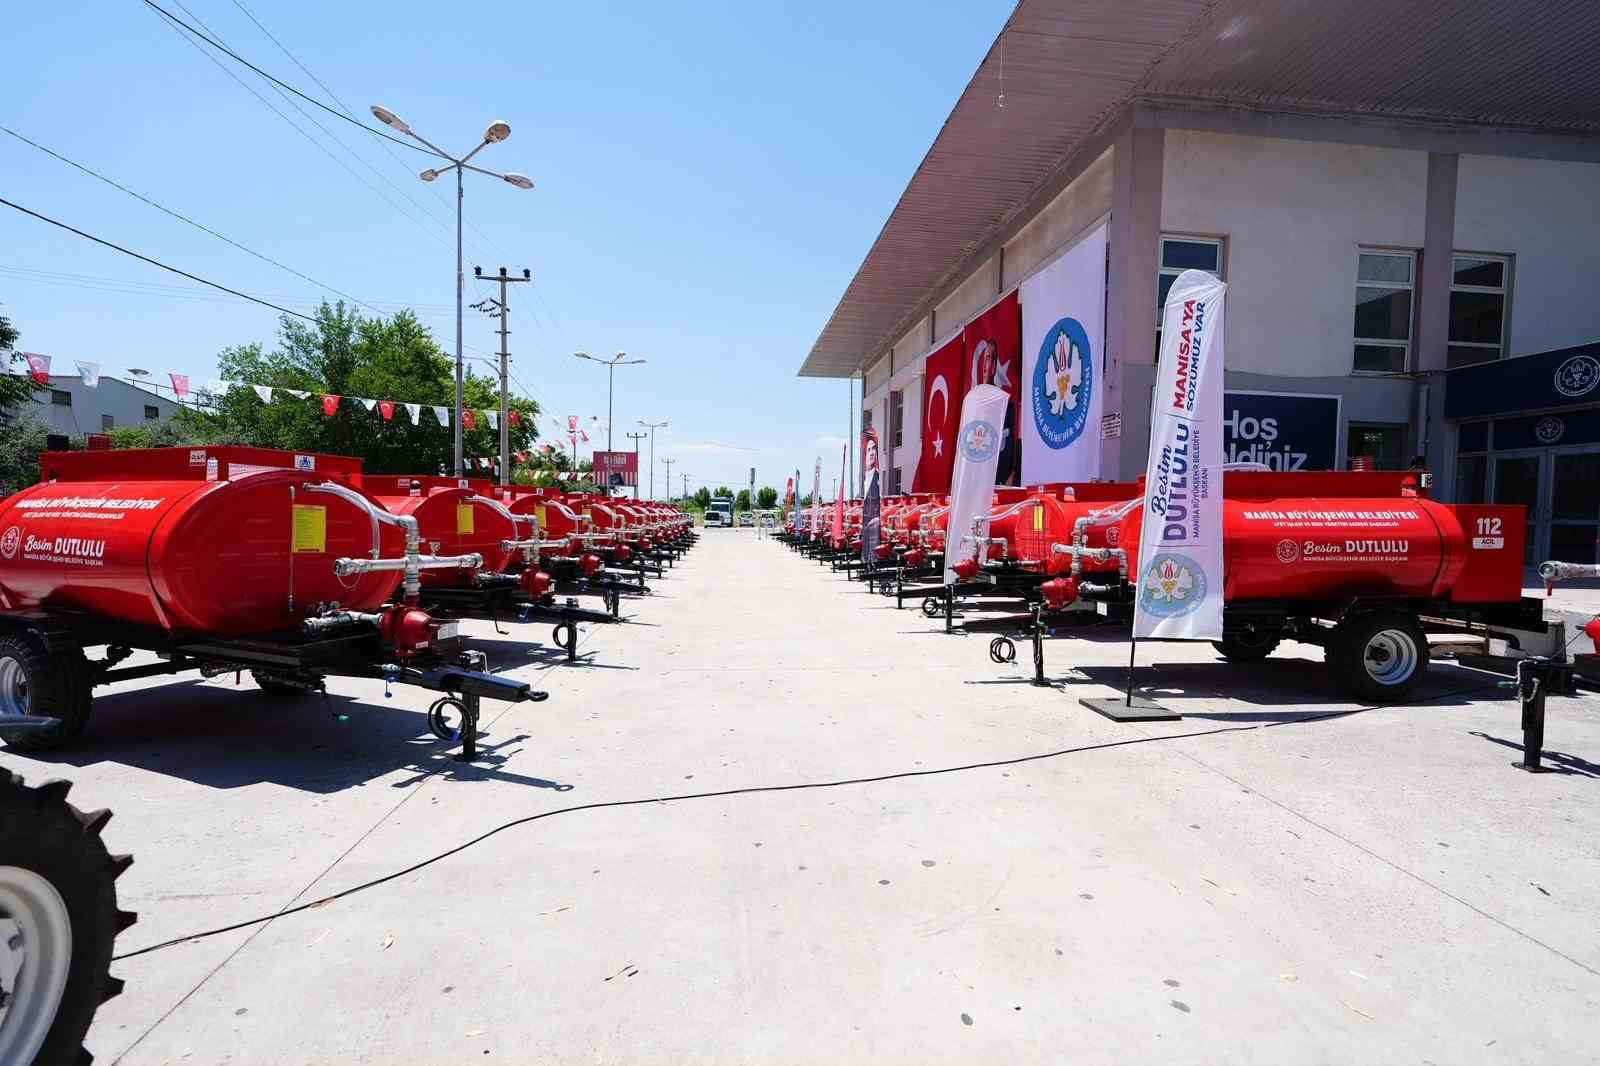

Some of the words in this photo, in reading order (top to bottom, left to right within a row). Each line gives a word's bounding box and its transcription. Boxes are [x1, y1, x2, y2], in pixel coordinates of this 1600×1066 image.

[1194, 302, 1206, 333] VAR
[1173, 299, 1196, 409] MANİSA'YA
[1151, 444, 1172, 517] Besim
[1163, 423, 1190, 540] DUTLULU
[1243, 509, 1286, 520] MANİSA
[1477, 517, 1502, 535] 112
[25, 534, 53, 552] Besim
[54, 537, 105, 557] DUTLULU
[1303, 541, 1342, 555] Besim
[1345, 540, 1408, 553] DUTLULU
